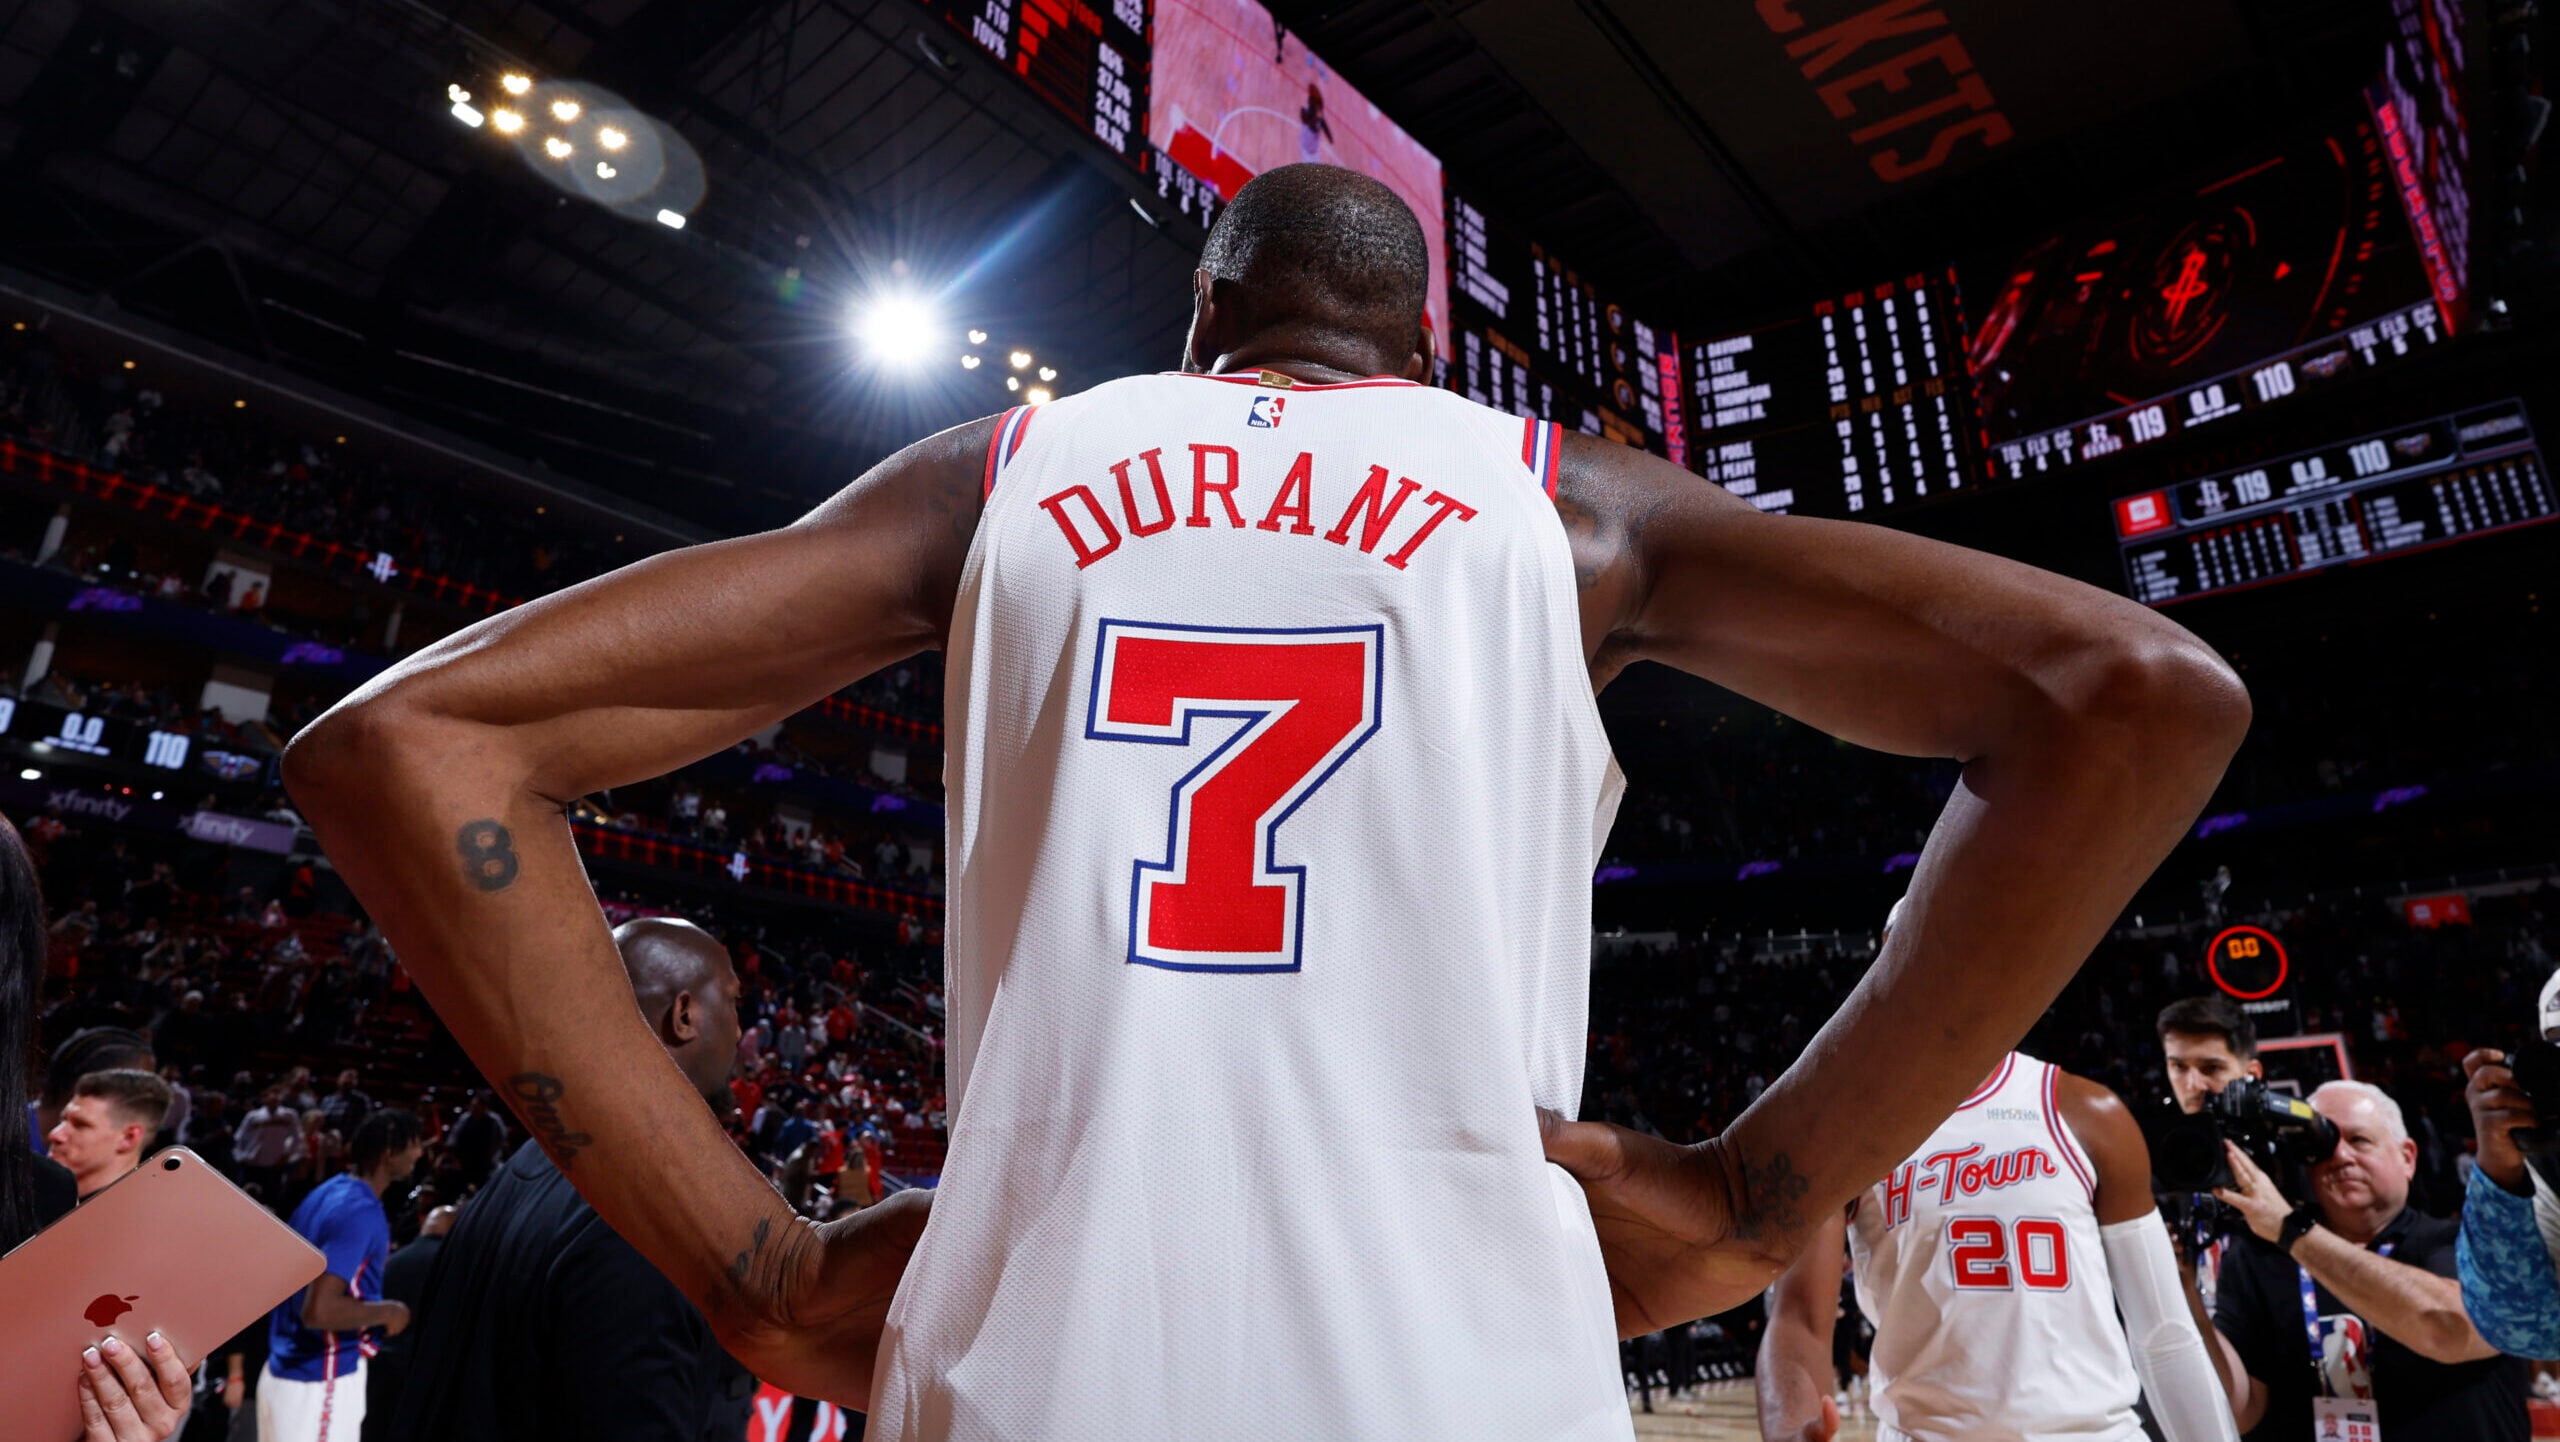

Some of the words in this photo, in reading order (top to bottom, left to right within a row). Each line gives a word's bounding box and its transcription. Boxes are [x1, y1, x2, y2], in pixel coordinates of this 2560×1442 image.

[1250, 419, 1268, 428] NBA
[2128, 405, 2168, 443] 119
[2189, 384, 2225, 416] 0.0
[2253, 361, 2295, 401] 110
[1842, 437, 1851, 455] 7
[2232, 469, 2272, 505] 119
[2347, 439, 2391, 477] 110
[1039, 443, 1477, 571] DURANT
[61, 712, 105, 746] 0.0
[144, 729, 190, 770] 110
[177, 810, 253, 844] xfinity
[1085, 617, 1384, 973] 7
[455, 818, 520, 893] 8
[1881, 1142, 2060, 1232] H-Town
[1946, 1215, 2072, 1292] 20
